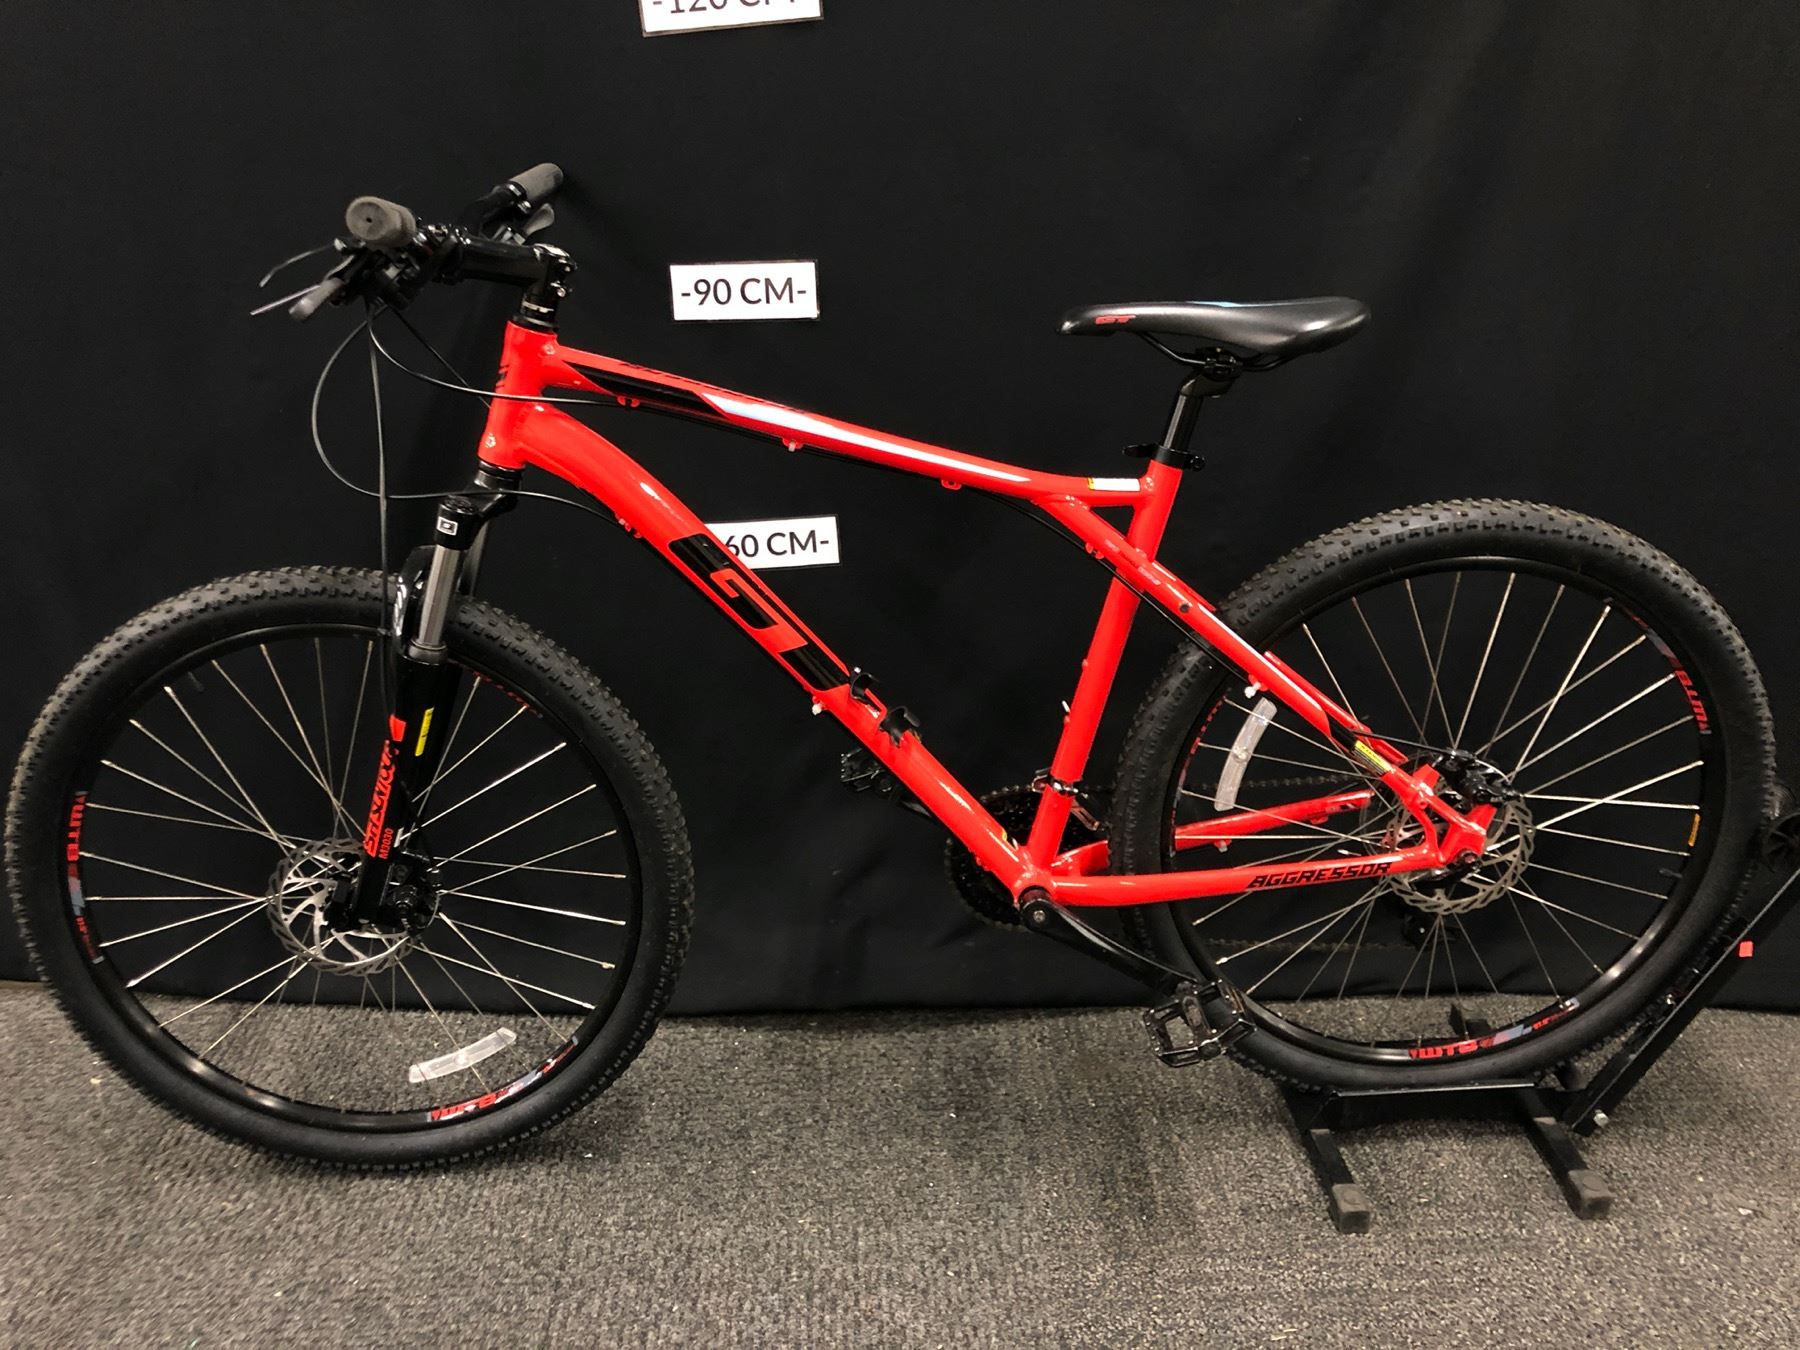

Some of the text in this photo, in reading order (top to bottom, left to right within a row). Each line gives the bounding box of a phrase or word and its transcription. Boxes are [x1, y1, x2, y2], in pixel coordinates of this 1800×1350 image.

[681, 277, 806, 305] -90 CM-
[767, 529, 829, 556] CM-
[668, 533, 850, 691] GT
[379, 828, 394, 859] M3030
[1247, 862, 1392, 888] AGGRESSOR
